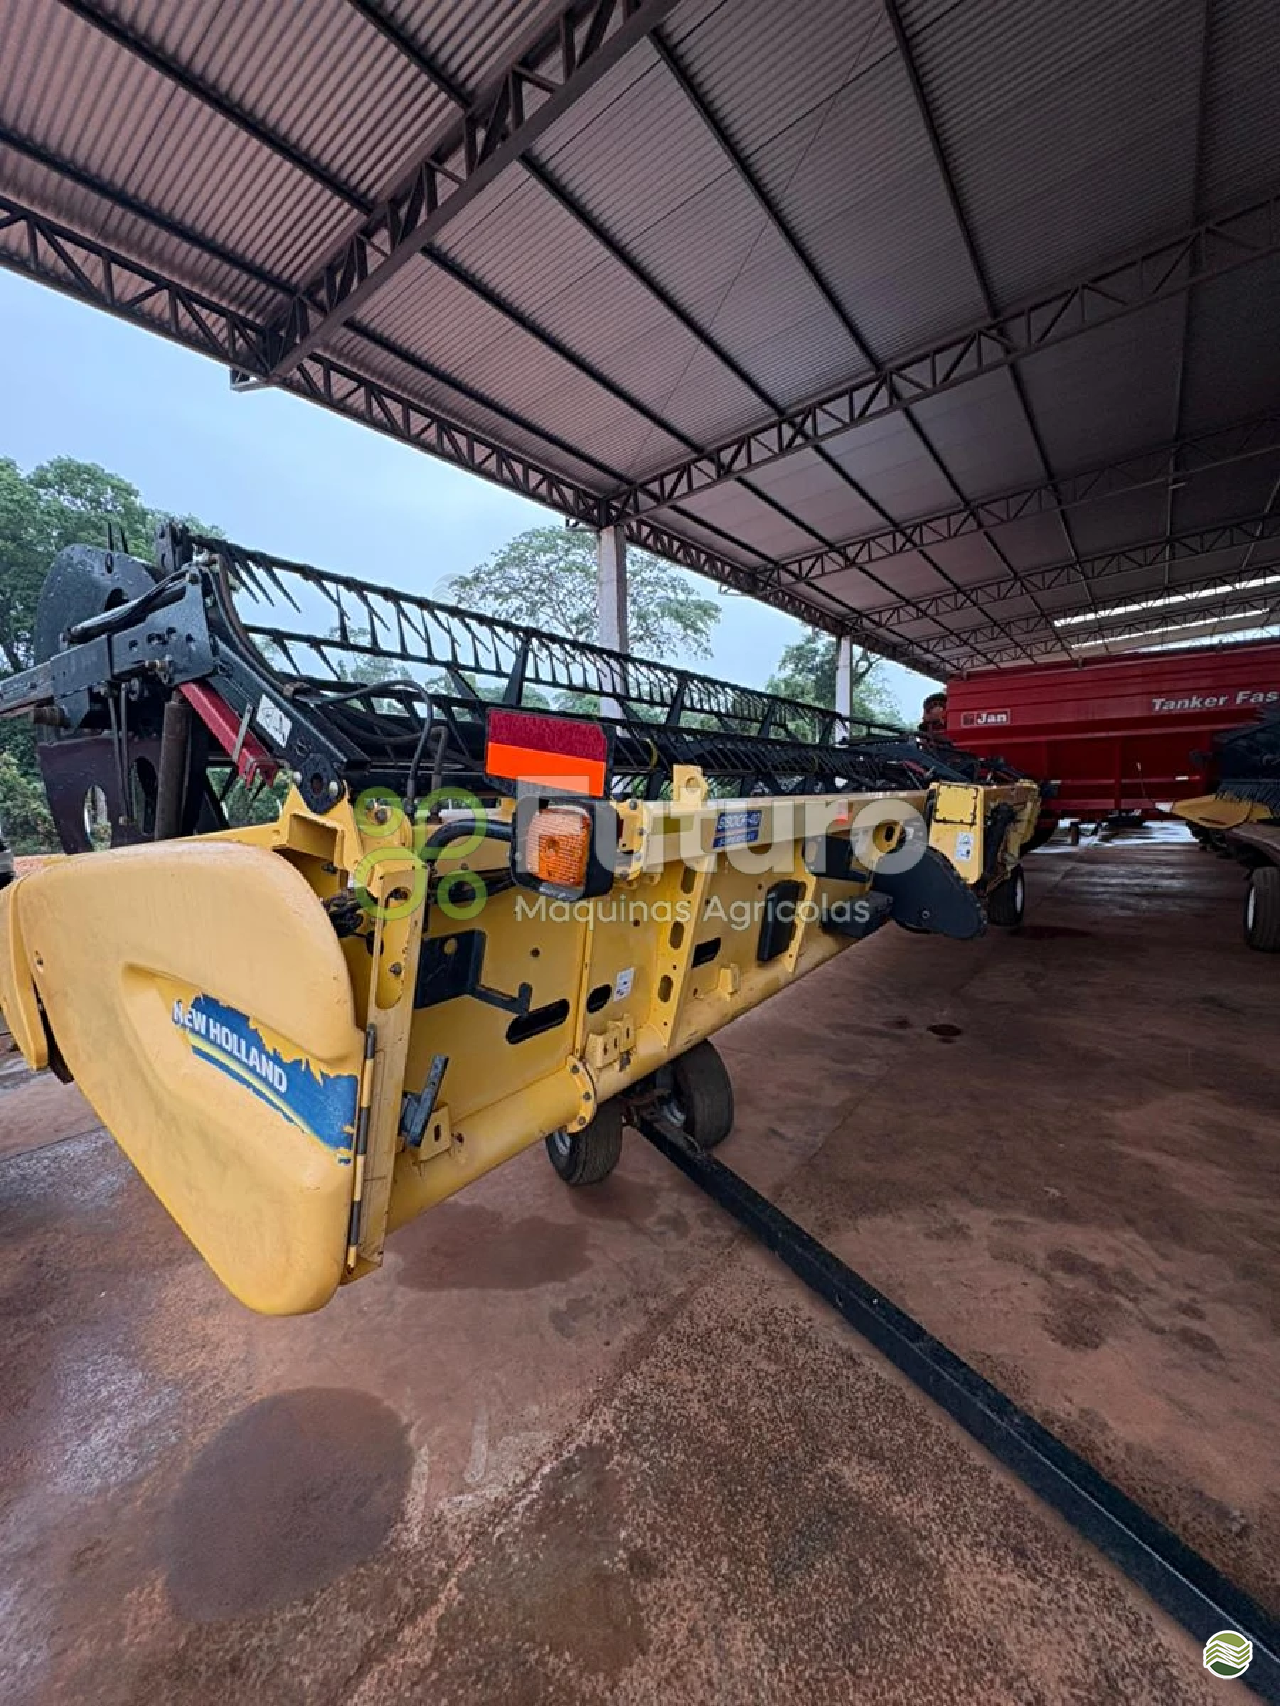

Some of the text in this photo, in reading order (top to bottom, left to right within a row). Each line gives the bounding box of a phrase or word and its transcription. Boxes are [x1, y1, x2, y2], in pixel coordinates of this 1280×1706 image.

[1152, 695, 1228, 711] Tanker
[977, 713, 1007, 724] Jan
[172, 998, 288, 1094] NEW HOLLAND
